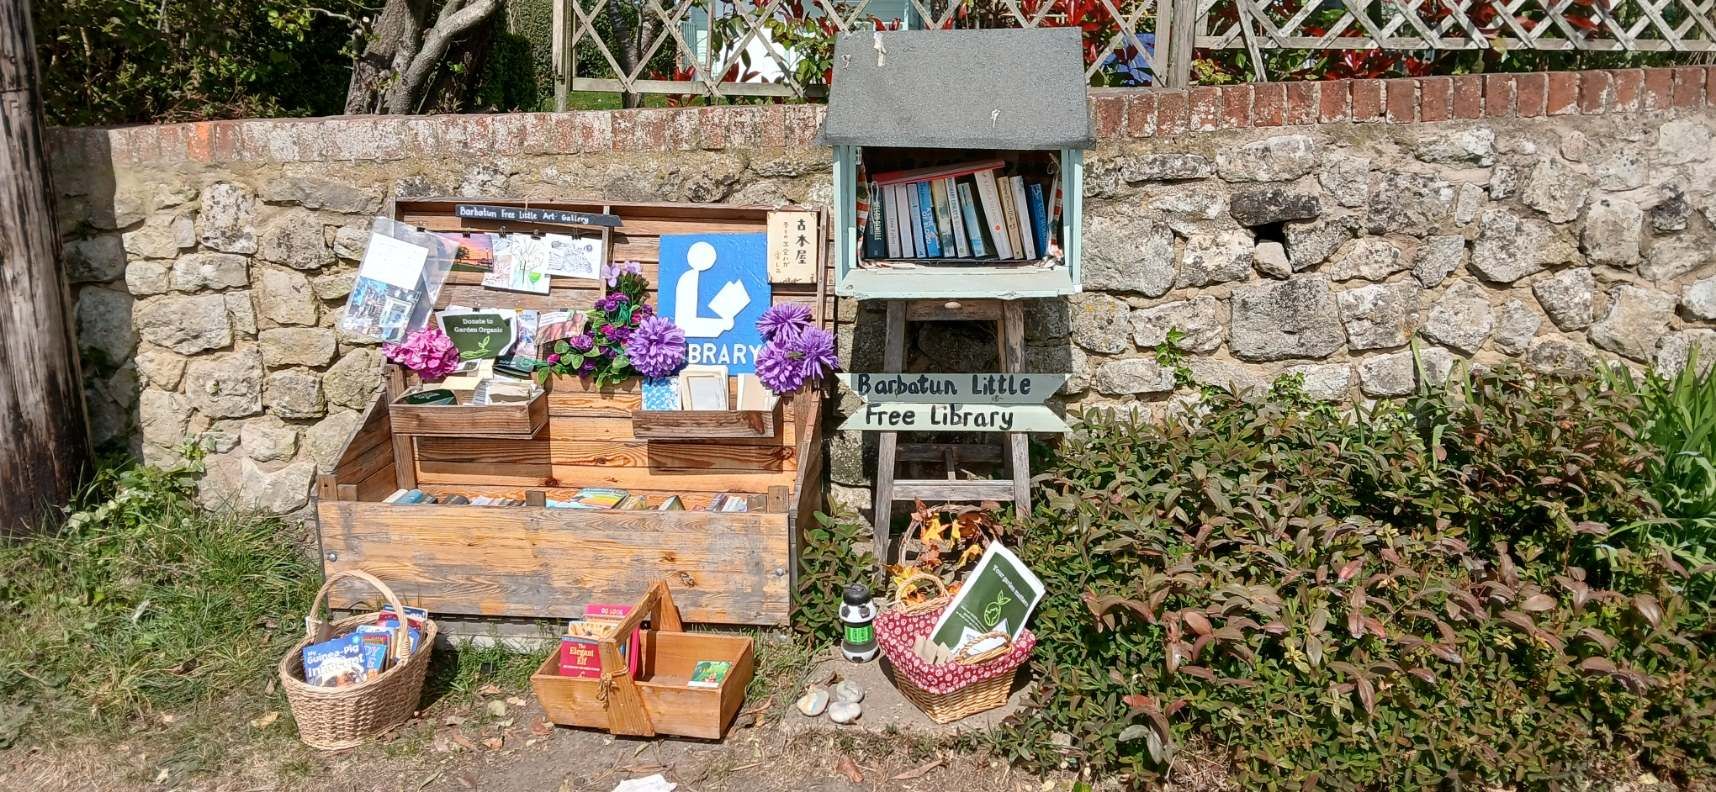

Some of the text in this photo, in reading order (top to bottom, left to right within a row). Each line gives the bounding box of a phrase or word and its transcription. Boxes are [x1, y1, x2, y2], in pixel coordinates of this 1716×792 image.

[460, 206, 497, 218] Barbatun
[501, 208, 515, 219] Free
[519, 211, 538, 220] Little
[561, 214, 589, 224] Gallery
[479, 326, 503, 334] Organic
[688, 342, 761, 365] BRARY
[857, 373, 1031, 397] Barbatun Little
[865, 402, 1014, 430] Free Library
[569, 646, 594, 658] Elegant
